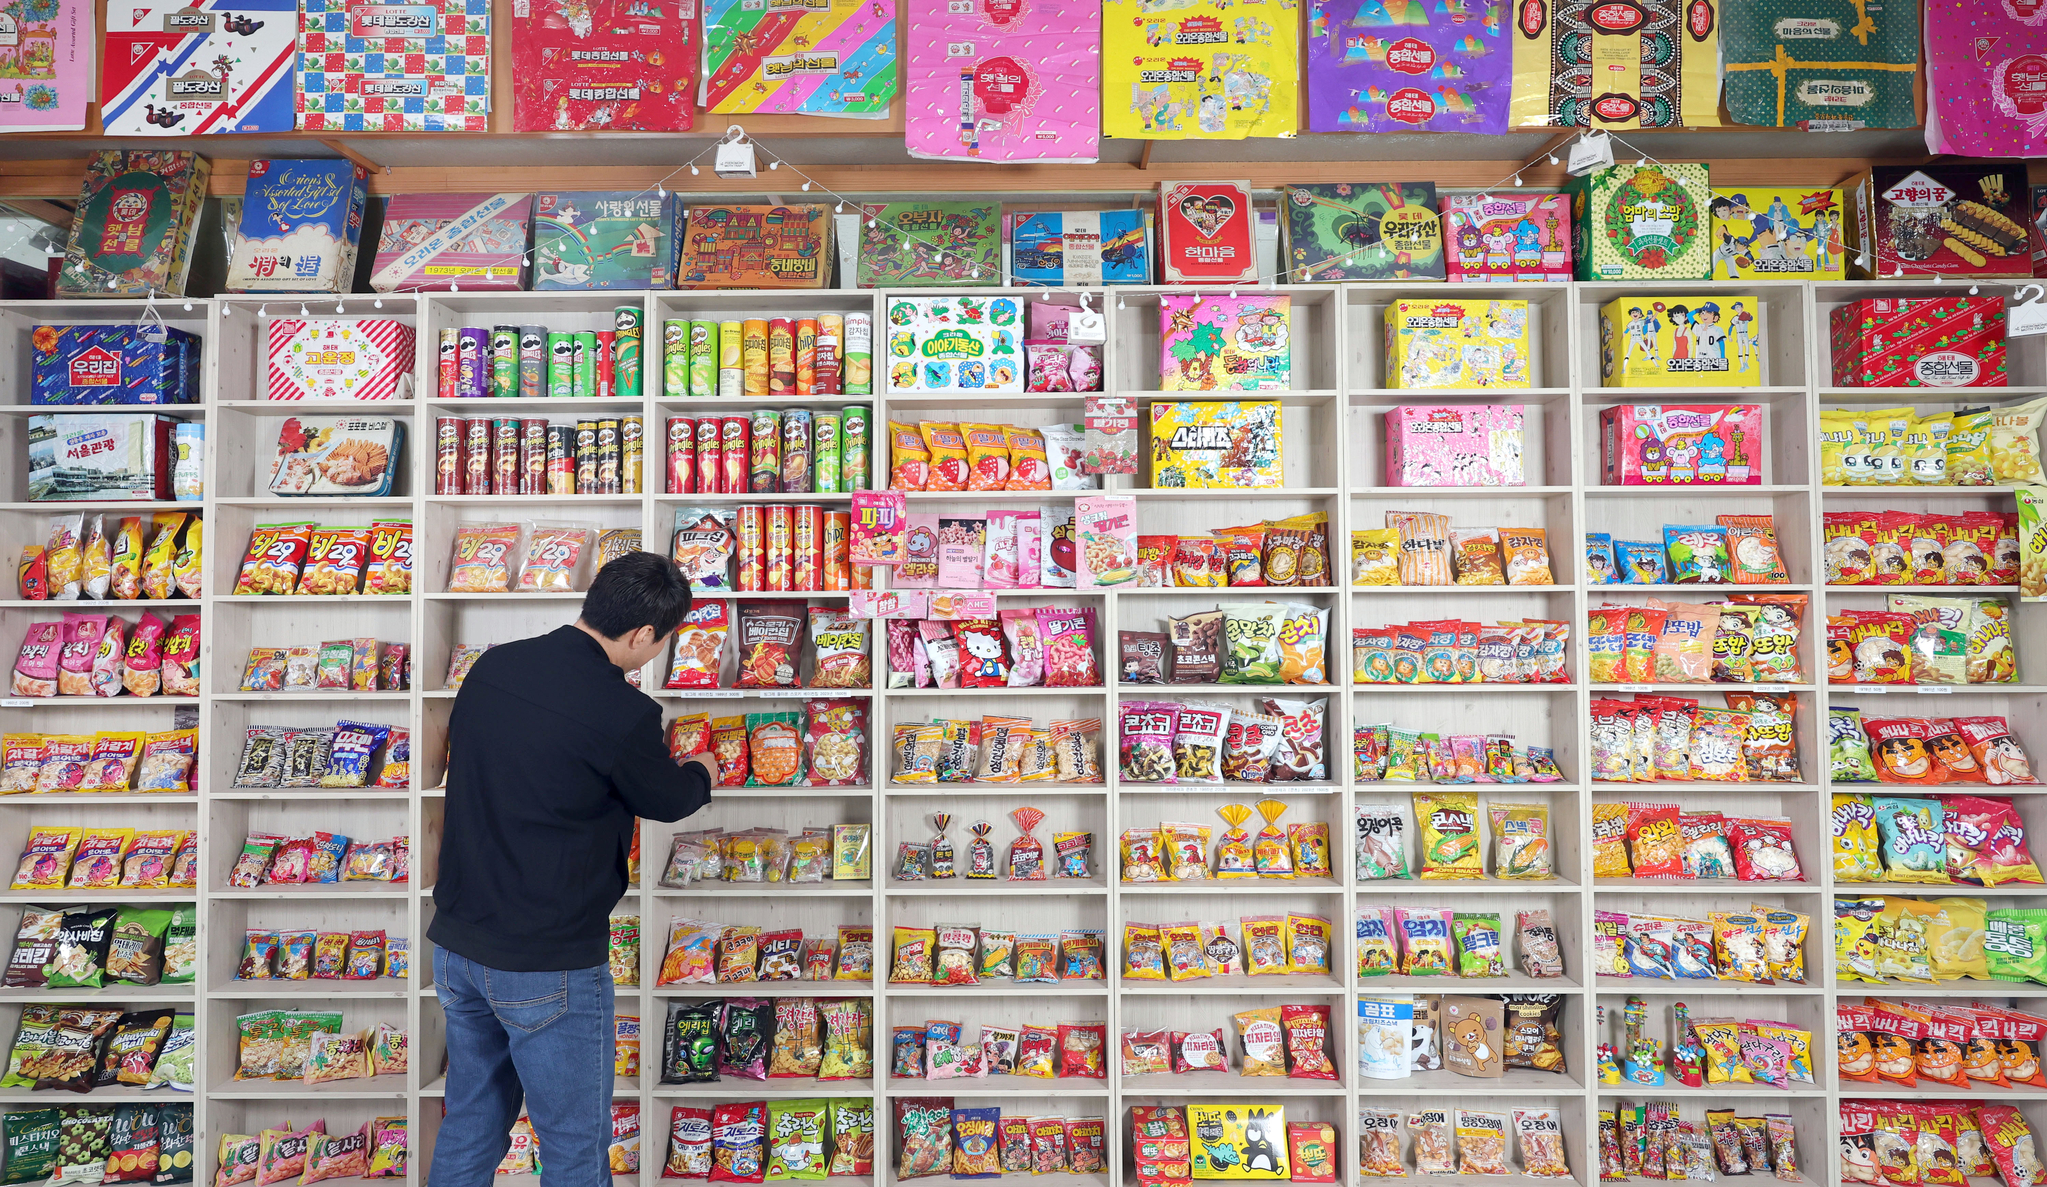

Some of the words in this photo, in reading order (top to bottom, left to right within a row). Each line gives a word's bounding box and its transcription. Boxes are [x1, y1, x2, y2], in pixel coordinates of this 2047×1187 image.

[170, 15, 209, 26] 팔도강산
[361, 15, 430, 28] 롯데팔도강산
[1175, 31, 1230, 45] 오리온종합선물
[1388, 49, 1432, 64] 종합선물
[1140, 70, 1197, 83] 오리온종합선물
[172, 80, 222, 94] 팔도강산
[364, 83, 422, 95] 롯데팔도강산
[179, 101, 213, 110] 종합선물
[1389, 99, 1432, 114] 종합선물
[1890, 187, 1931, 202] 고향의
[1931, 187, 1948, 202] 꿈
[1482, 201, 1527, 216] 종합선물
[1623, 204, 1658, 223] 엄마의
[1658, 204, 1682, 222] 소망
[898, 209, 945, 224] 오부자
[403, 238, 445, 270] 오리온
[447, 196, 509, 241] 종합선물
[1184, 245, 1236, 259] 한마음
[1394, 240, 1432, 251] 종합선물
[428, 266, 456, 275] 1973년
[459, 266, 483, 276] 오리온
[1753, 258, 1815, 273] 오리온종합선물
[1405, 315, 1459, 329] 오리온종합선물
[848, 326, 869, 337] 감자칩
[322, 343, 339, 351] 해태
[927, 338, 981, 355] 이야기동산
[305, 351, 356, 366] 고운정
[1666, 357, 1731, 373] 오리온종합선물
[72, 360, 118, 375] 우리집
[1920, 360, 1974, 377] 종합선물
[1666, 414, 1712, 430] 종합선물
[67, 438, 116, 460] 서울관광
[668, 438, 694, 453] Pringles
[752, 434, 777, 451] Pringles
[1770, 570, 1786, 580] 100
[748, 626, 790, 638] 베이컨칩
[1047, 616, 1088, 637] 딸기콘
[815, 631, 865, 650] 베이컨칩
[1123, 712, 1172, 736] 콘쵸코
[1179, 711, 1219, 735] 콘쵸코
[1240, 768, 1265, 780] Original
[1356, 816, 1404, 840] 오징어콘
[1429, 811, 1475, 832] 콘스낵
[1892, 827, 1946, 856] 바나나킥
[1402, 919, 1448, 939] 엄지
[1632, 920, 1664, 934] 슈퍼콘
[1364, 1002, 1397, 1018] 곰표
[1519, 1010, 1542, 1018] cookies
[1519, 1025, 1540, 1036] 스모어
[121, 1036, 146, 1052] Ball
[723, 1124, 760, 1138] 치토스
[776, 1112, 820, 1137] 츄러스
[1520, 1118, 1559, 1132] 오징어
